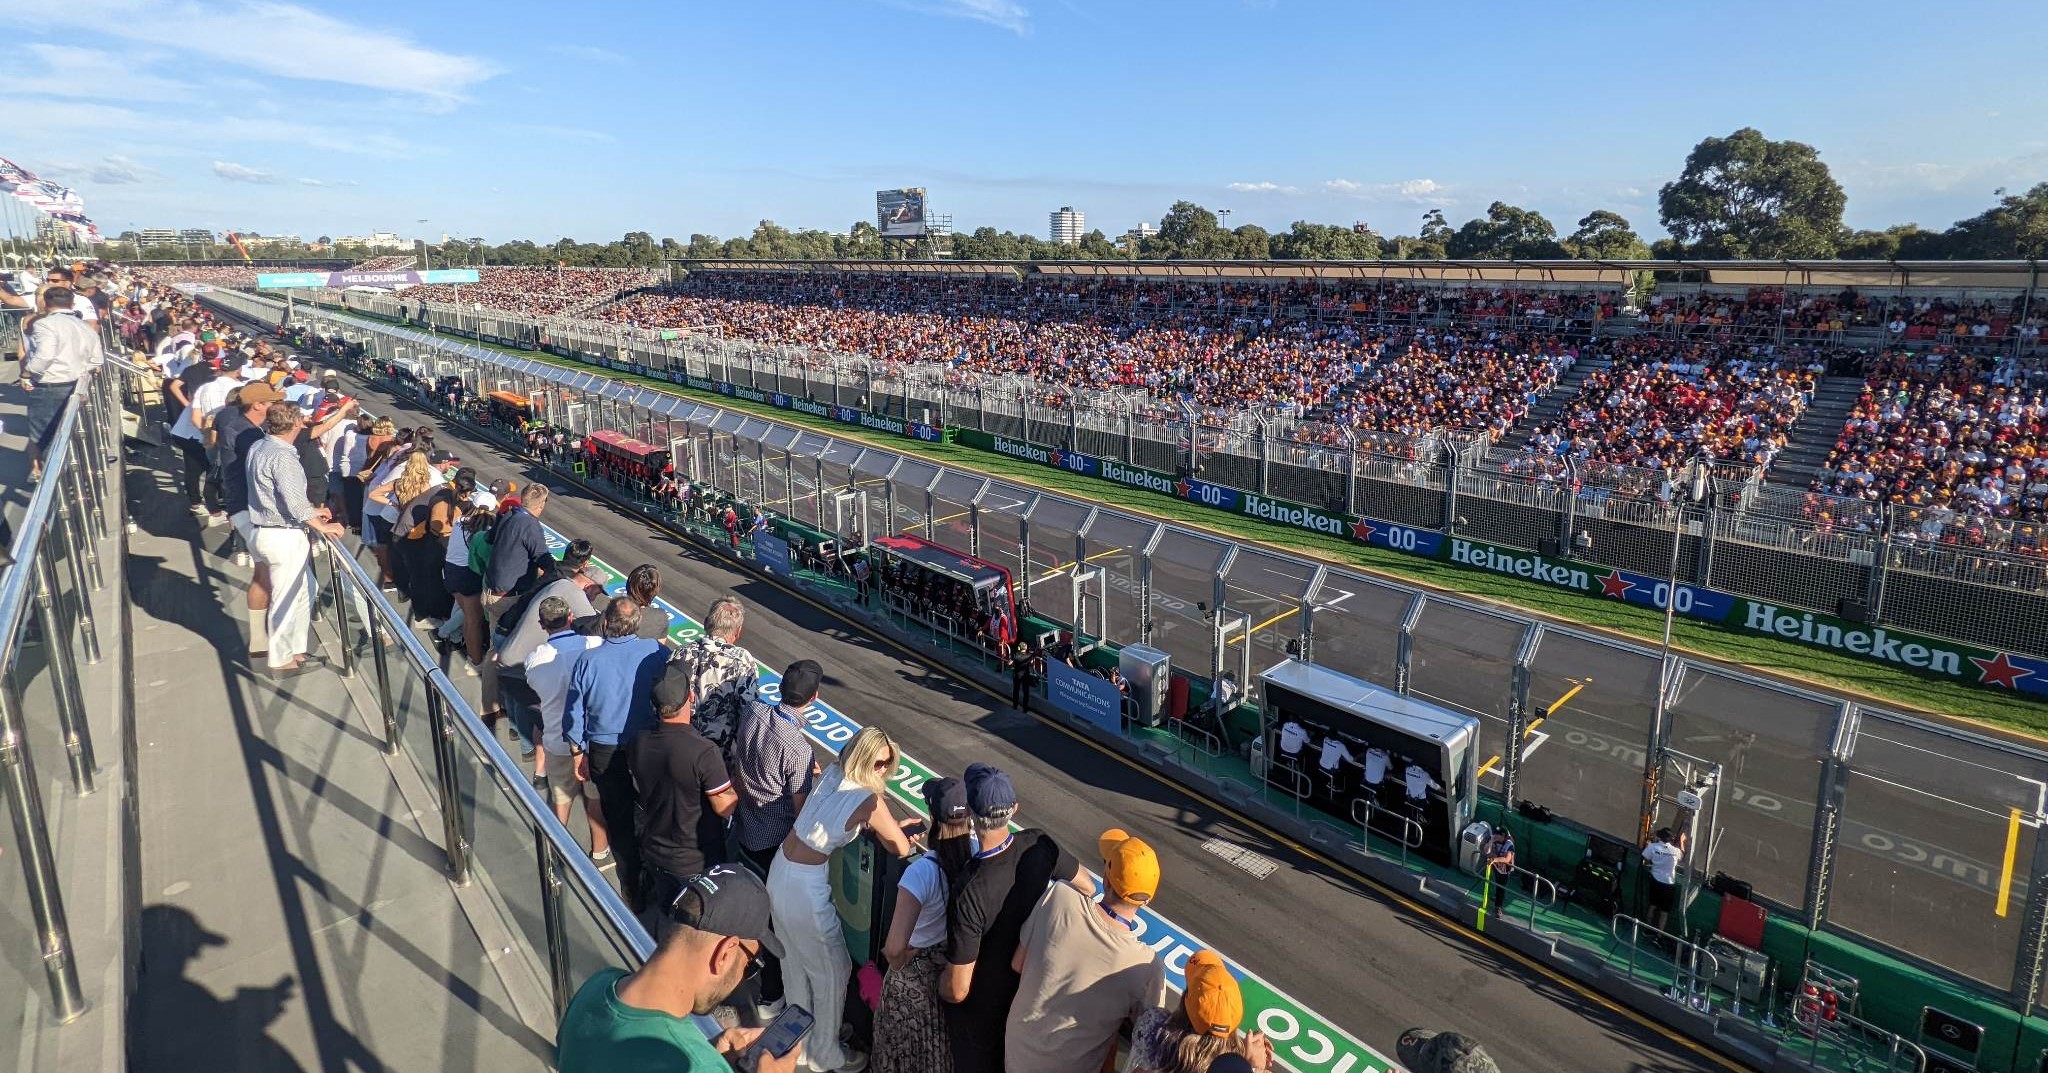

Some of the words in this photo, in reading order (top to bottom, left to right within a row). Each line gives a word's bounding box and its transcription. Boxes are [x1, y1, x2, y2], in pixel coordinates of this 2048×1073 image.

[342, 274, 408, 283] MELBOURNE
[735, 385, 765, 402] Heineken
[792, 397, 827, 417] Heineken
[860, 412, 903, 433] Heineken
[994, 436, 1048, 462] Heineken
[1102, 461, 1172, 493] Heineken
[1244, 494, 1343, 535] Heineken
[1450, 539, 1590, 590] Heineken
[1744, 601, 1962, 675] Heineken
[1055, 678, 1111, 708] COMMUNICATIONS
[1071, 678, 1090, 691] TATA
